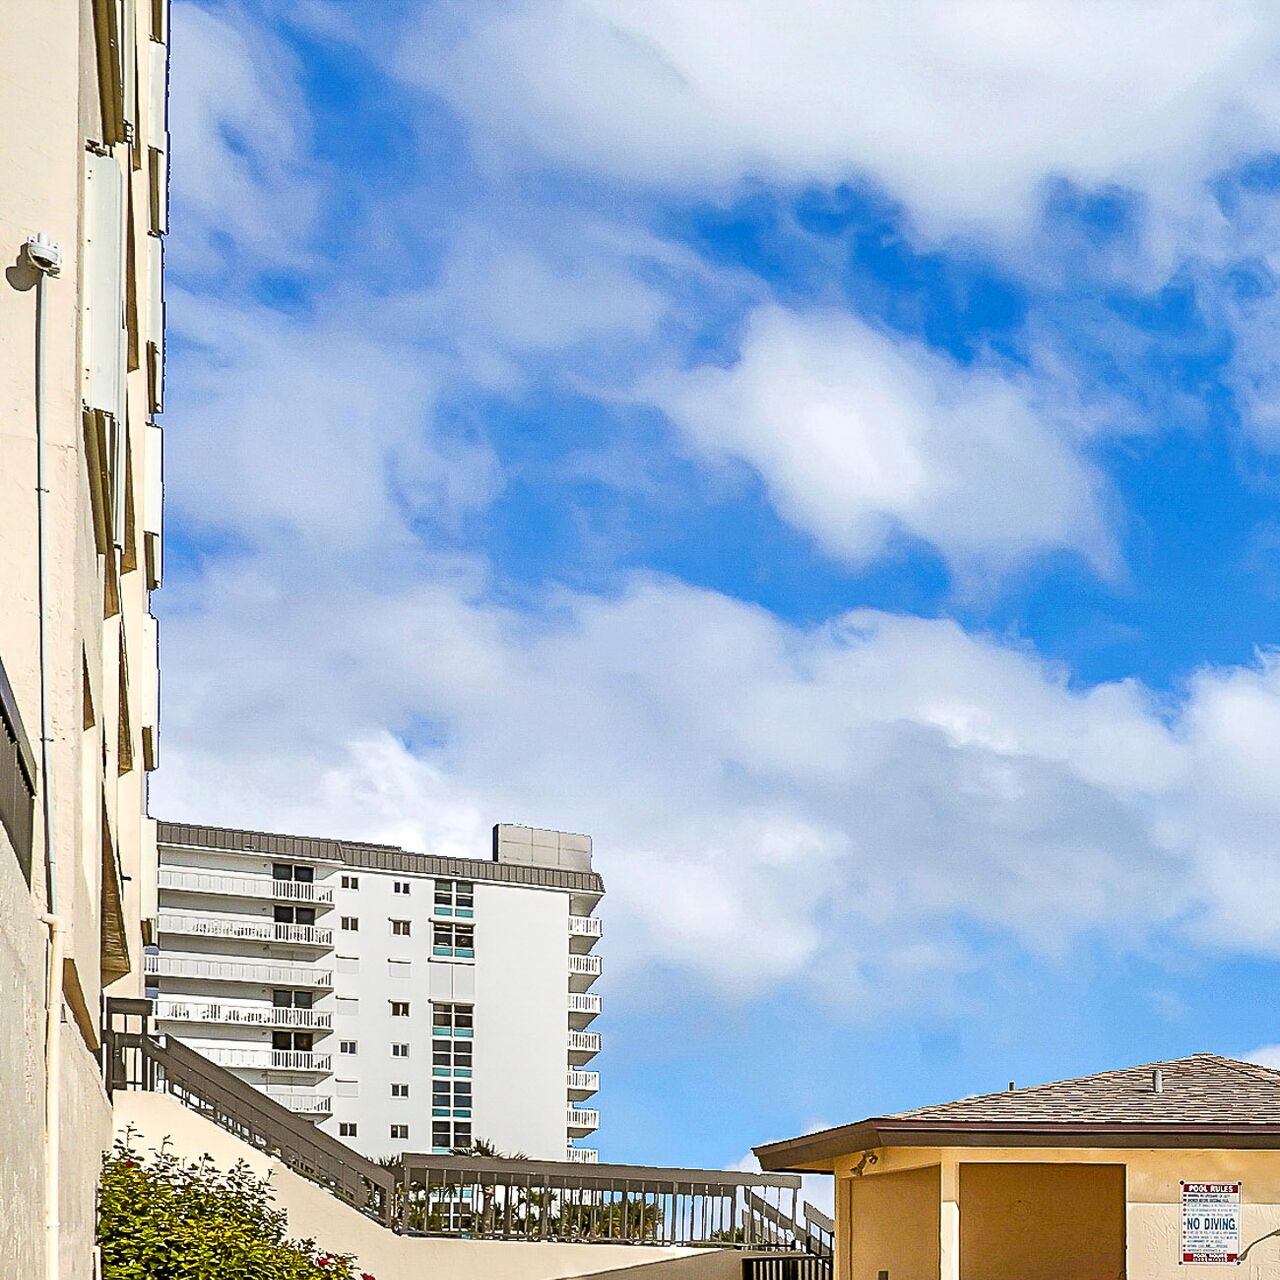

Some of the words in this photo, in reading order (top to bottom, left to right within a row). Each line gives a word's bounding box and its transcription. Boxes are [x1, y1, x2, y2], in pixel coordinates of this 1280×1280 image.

[1189, 1184, 1208, 1193] POOL
[1210, 1185, 1234, 1193] RULES
[1187, 1217, 1200, 1230] NO
